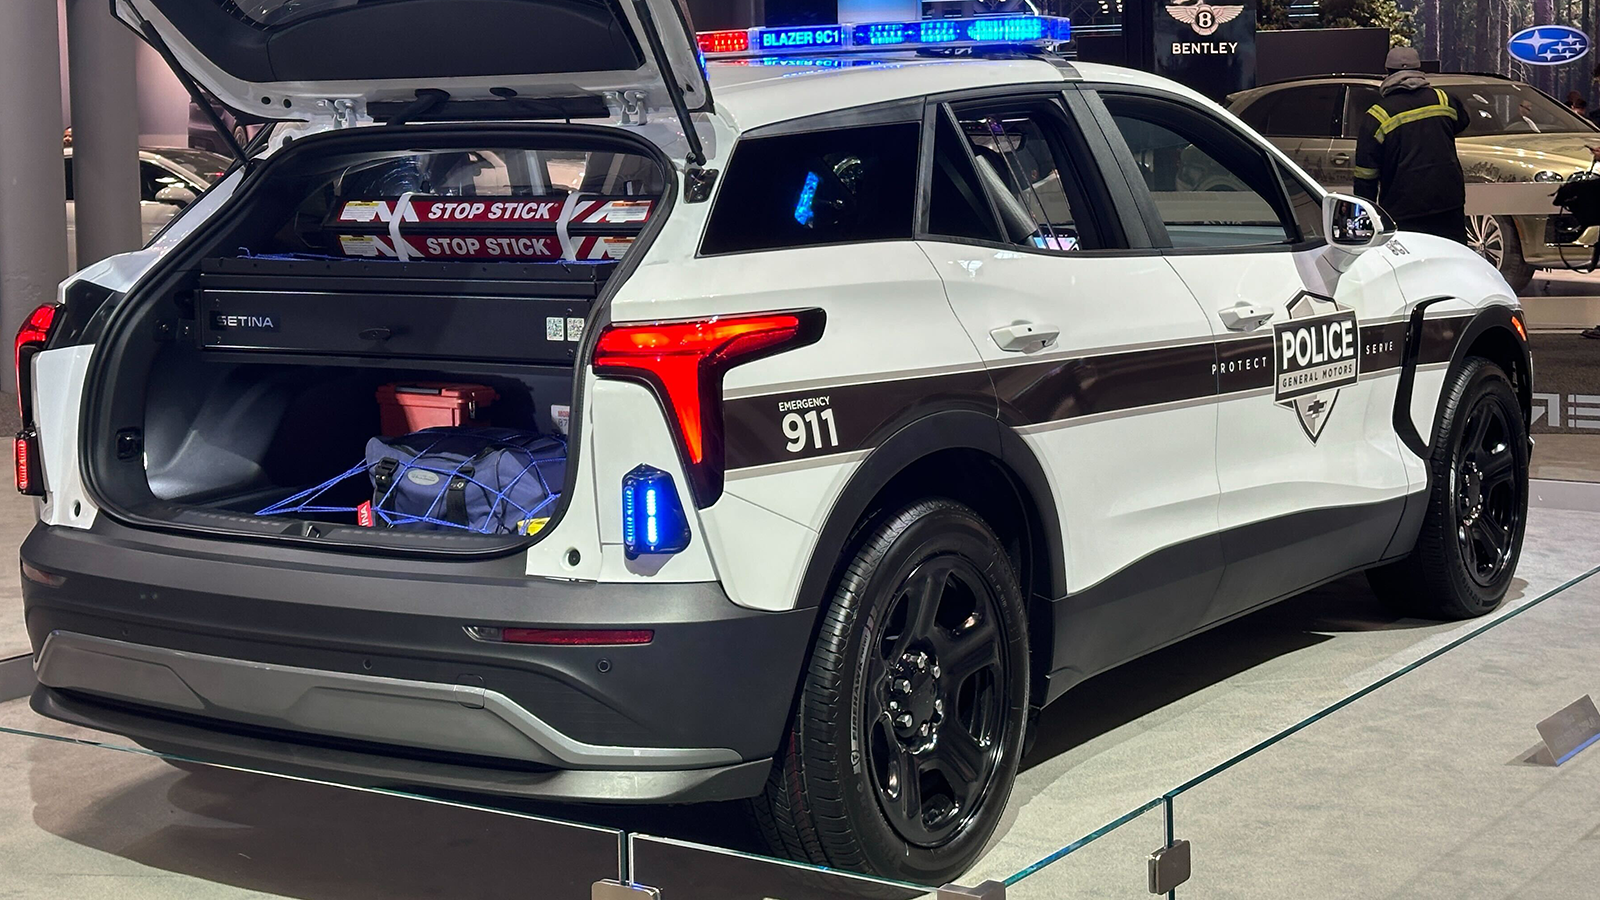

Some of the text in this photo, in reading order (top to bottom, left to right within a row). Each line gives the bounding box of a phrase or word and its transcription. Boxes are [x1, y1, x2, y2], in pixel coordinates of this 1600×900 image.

[763, 30, 839, 46] BLAZER 9C1
[1172, 42, 1238, 54] BENTLEY
[428, 202, 485, 219] STOP
[426, 238, 480, 255] STOP
[217, 315, 274, 328] SETINA
[1281, 320, 1354, 370] POLICE
[1366, 341, 1393, 355] SERVE
[1211, 356, 1267, 375] PROTECT
[1282, 363, 1353, 388] GENERAL MOTORS
[778, 396, 830, 412] EMERGENCY
[782, 408, 839, 453] 911
[852, 660, 864, 741] FIREHAWK
